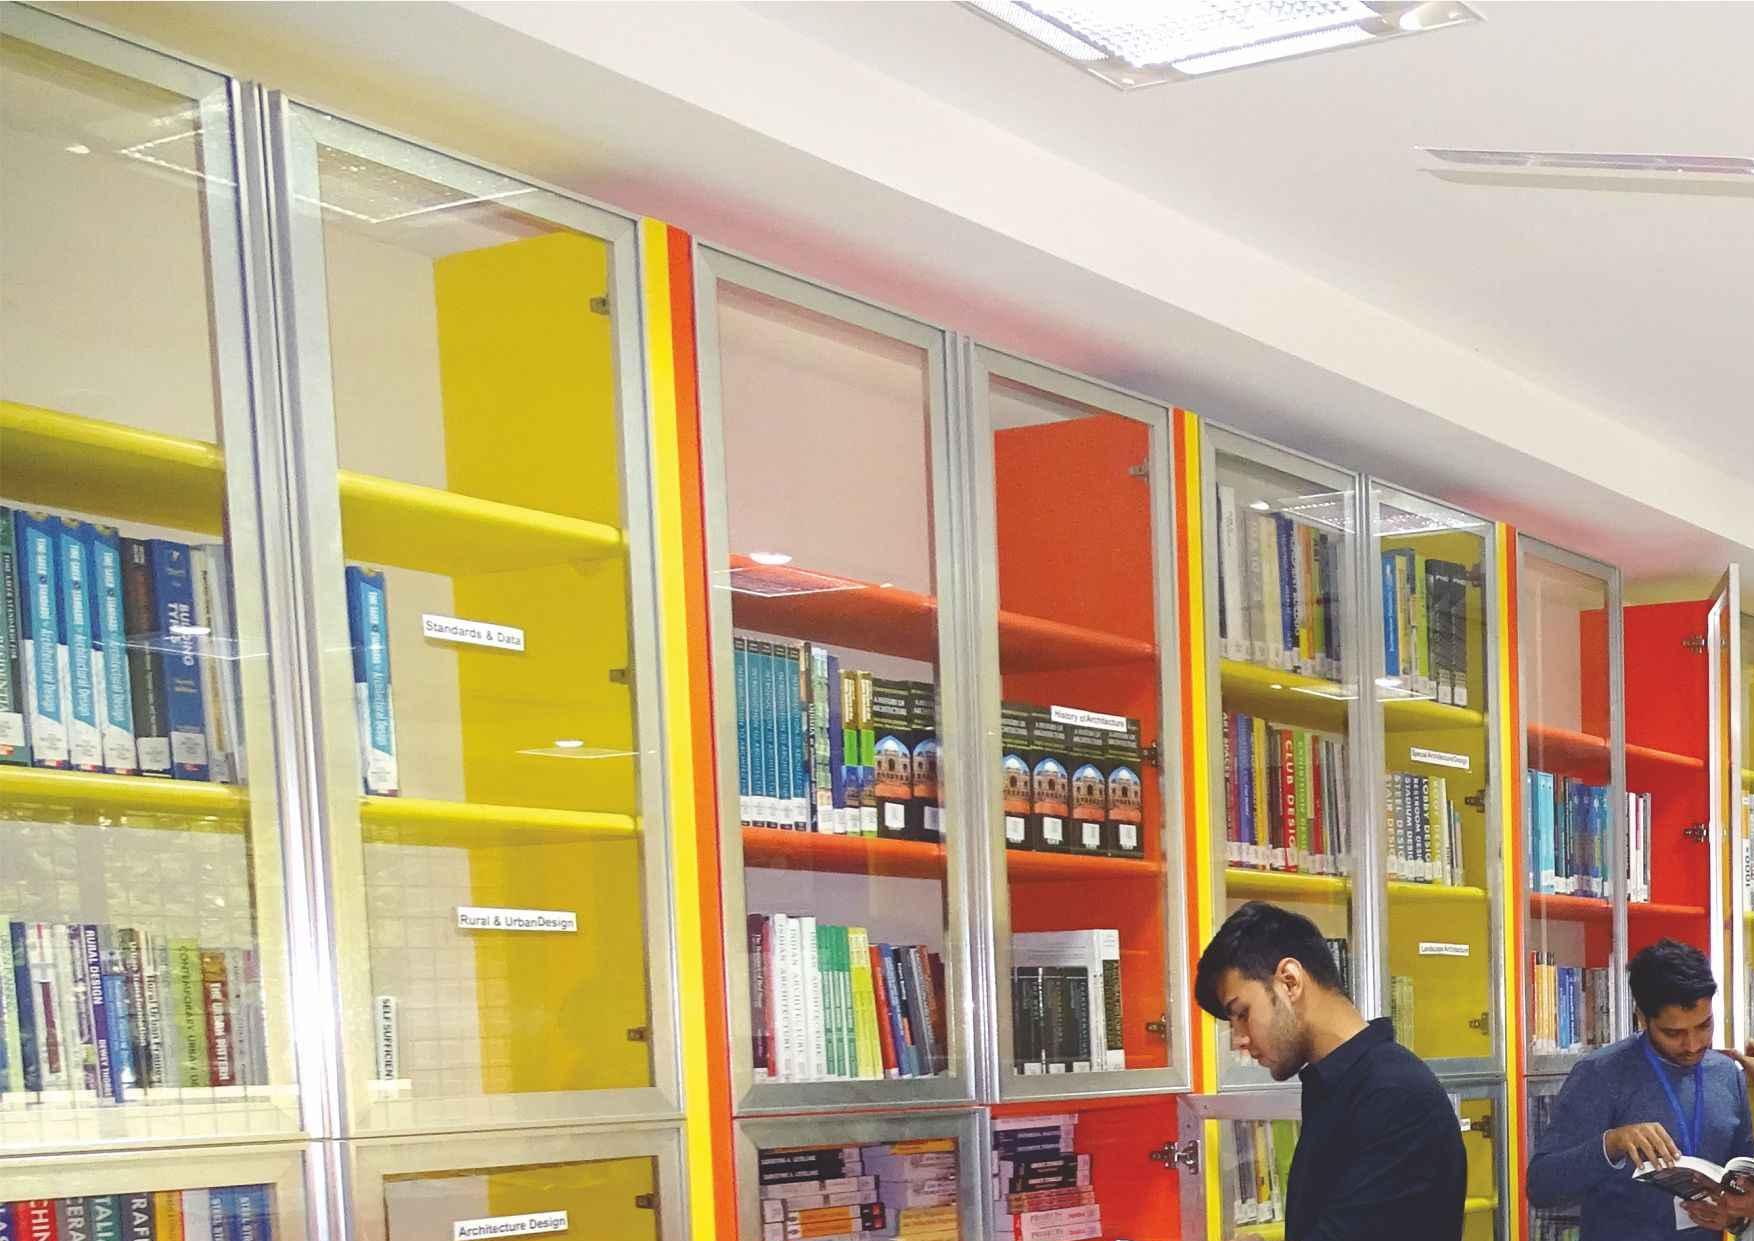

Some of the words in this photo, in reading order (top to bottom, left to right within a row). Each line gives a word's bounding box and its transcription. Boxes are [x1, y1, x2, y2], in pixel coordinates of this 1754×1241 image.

[168, 602, 179, 644] TYPS
[179, 602, 195, 666] BUIDING
[425, 620, 482, 640] Standards
[486, 631, 494, 641] &
[497, 632, 521, 646] Data
[40, 627, 57, 682] Architectural
[76, 633, 92, 687] Architectural
[42, 683, 57, 713] Design
[77, 688, 92, 717] Design
[1054, 710, 1078, 723] History
[1284, 740, 1294, 786] CLUB
[1394, 774, 1402, 814] STEEL
[1413, 778, 1421, 833] RESTROOM
[1386, 818, 1395, 857] DESIG
[1395, 820, 1404, 862] DESIG
[1424, 825, 1432, 863] DESIG
[460, 914, 491, 926] Rural
[494, 916, 502, 926] &
[86, 930, 98, 963] RURAL
[89, 966, 103, 1005] DESIGN
[146, 975, 159, 1004] Rural
[179, 945, 196, 1032] CONTEMPORARY
[210, 982, 223, 1000] THE
[148, 1006, 161, 1040] Urban
[212, 1003, 226, 1036] URBAN
[383, 998, 392, 1021] SELF
[98, 1039, 108, 1066] DEWEY
[215, 1039, 229, 1080] PATTERN
[211, 1198, 225, 1225] STEEL
[239, 1197, 253, 1224] STEEL
[458, 1221, 527, 1238] Architecture
[528, 1216, 567, 1230] Design
